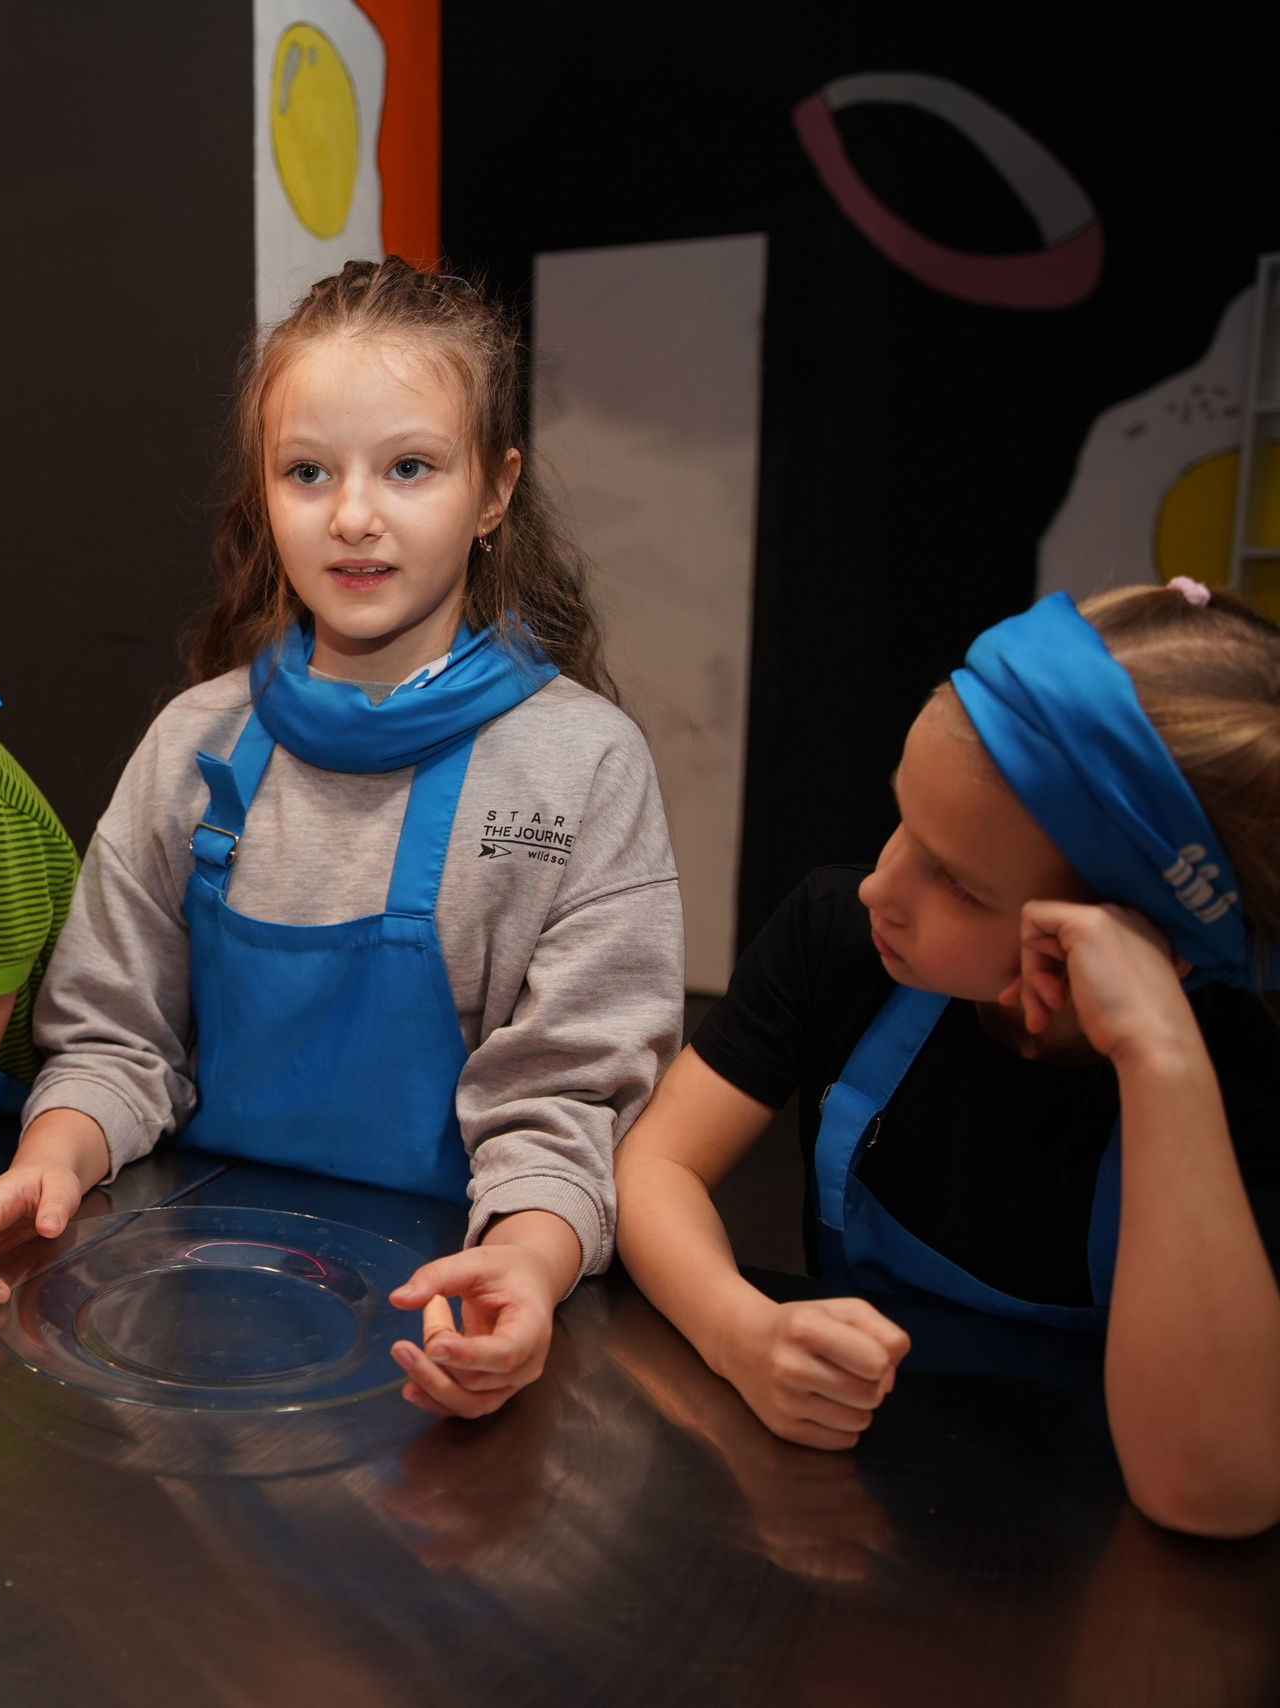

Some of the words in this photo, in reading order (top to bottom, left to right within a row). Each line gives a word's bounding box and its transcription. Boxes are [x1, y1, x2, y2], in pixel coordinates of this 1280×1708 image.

[483, 825, 512, 837] THE
[514, 826, 577, 848] JOURNE
[528, 850, 550, 862] wild
